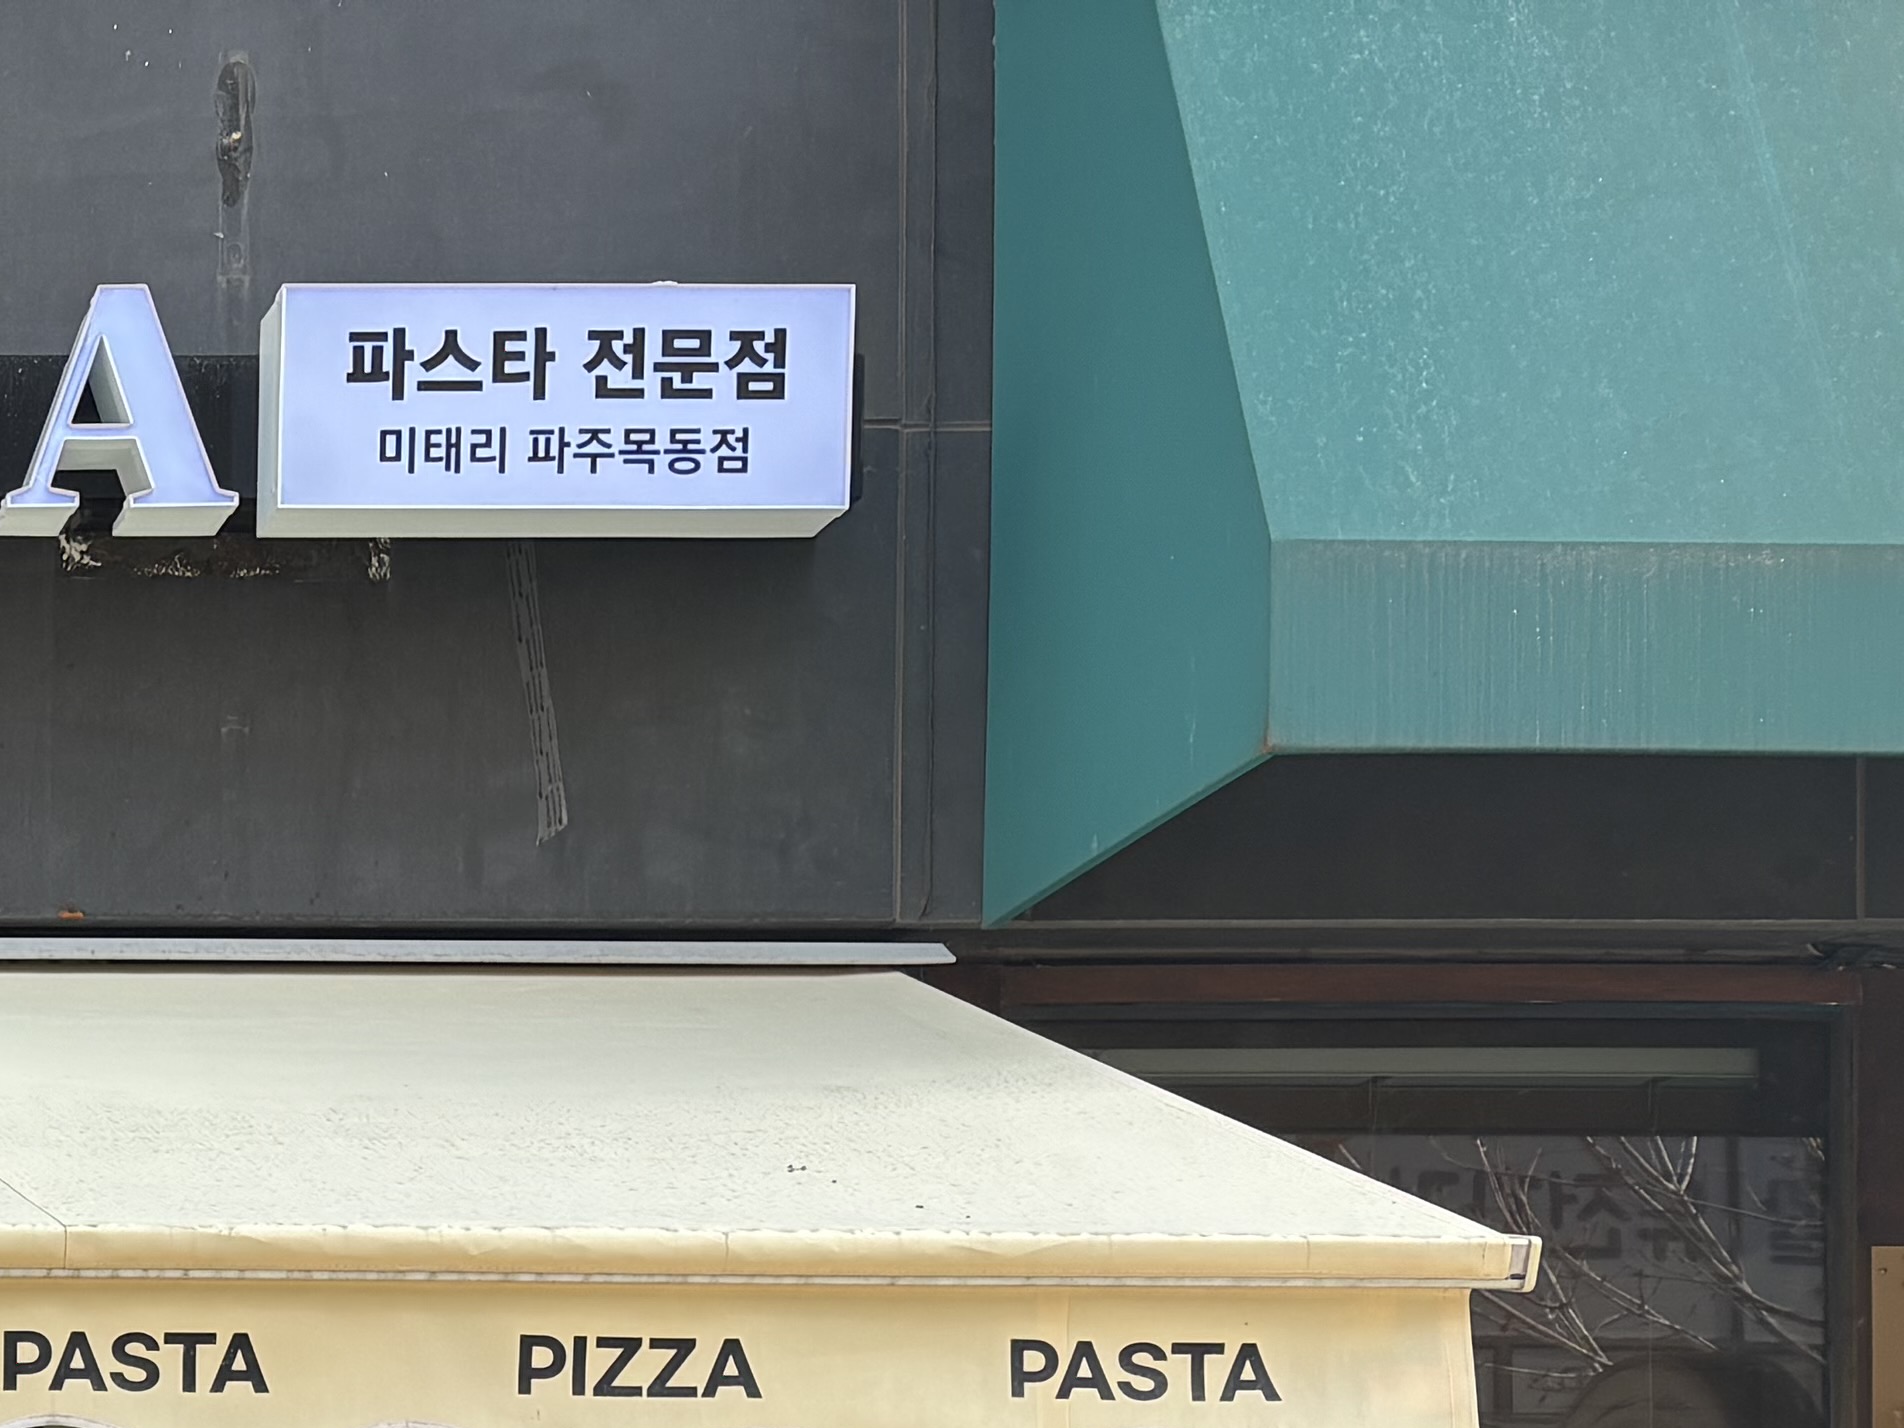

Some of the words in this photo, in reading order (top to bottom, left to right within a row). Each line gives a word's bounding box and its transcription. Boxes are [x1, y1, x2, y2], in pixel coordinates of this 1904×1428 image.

[345, 327, 556, 401] 파스타
[582, 327, 788, 401] 전문점
[378, 426, 508, 475] 미태리
[527, 426, 751, 475] 파주목동점
[0, 1330, 270, 1395] PASTA
[516, 1334, 762, 1399] PIZZA
[1008, 1338, 1282, 1402] PASTA
